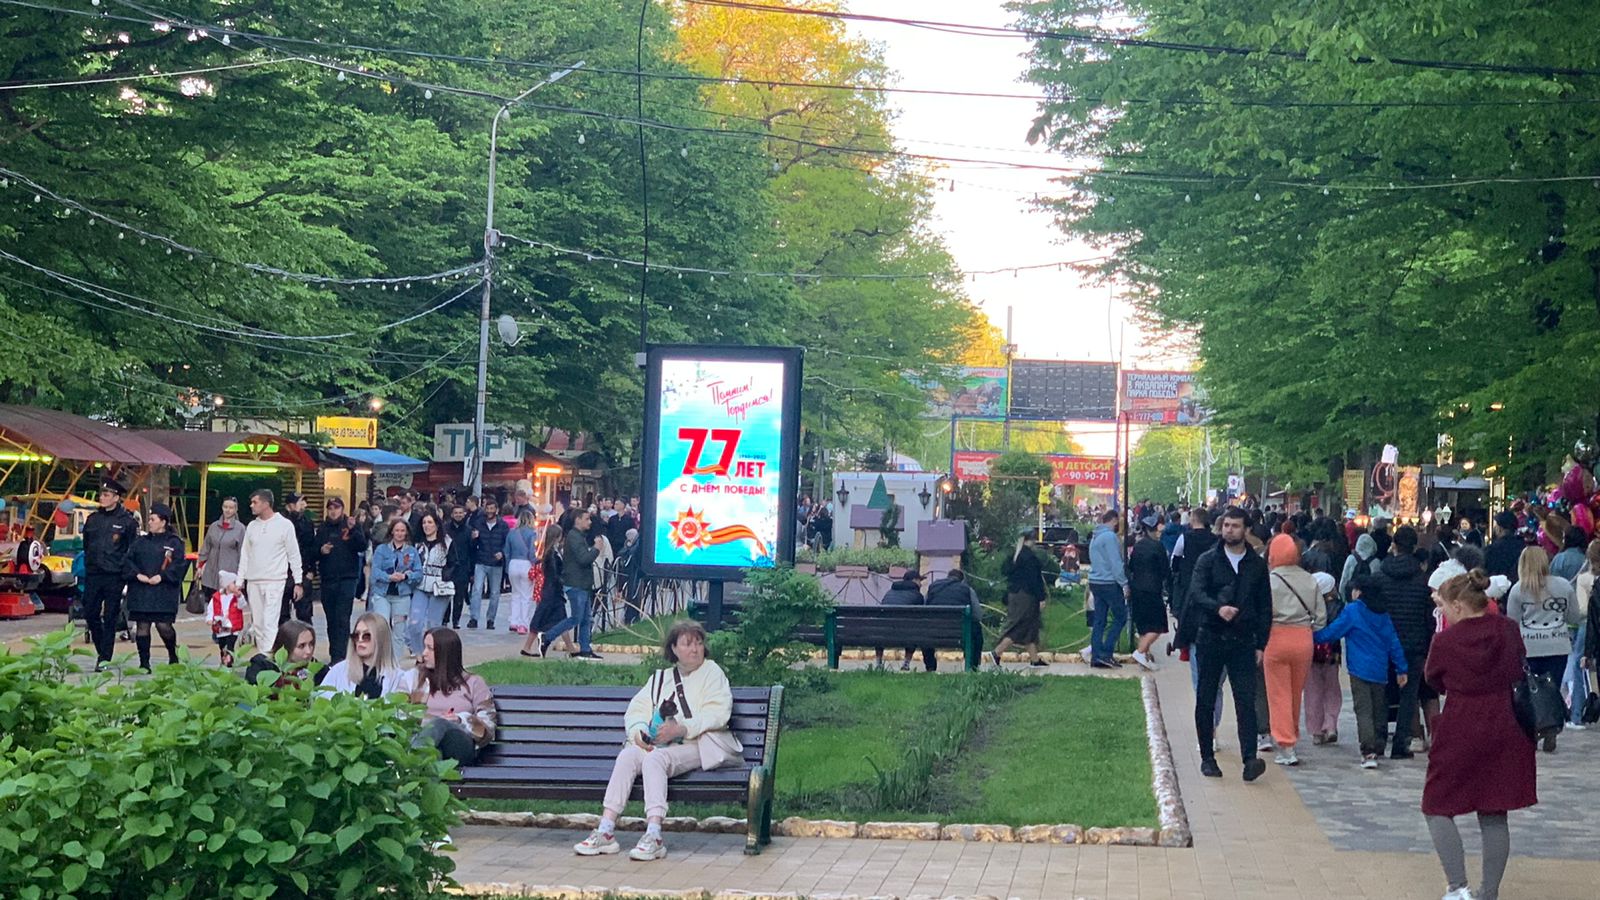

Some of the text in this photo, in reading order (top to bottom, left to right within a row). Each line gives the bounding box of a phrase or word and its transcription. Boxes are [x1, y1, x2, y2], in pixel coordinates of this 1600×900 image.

[706, 376, 753, 405] Помним!
[678, 428, 766, 478] 77 ЛЕТ
[1065, 461, 1111, 471] ДЕТСКАЯ
[680, 484, 687, 492] С
[724, 484, 766, 495] ПОБЕДЫ!
[1522, 632, 1549, 640] Hello
